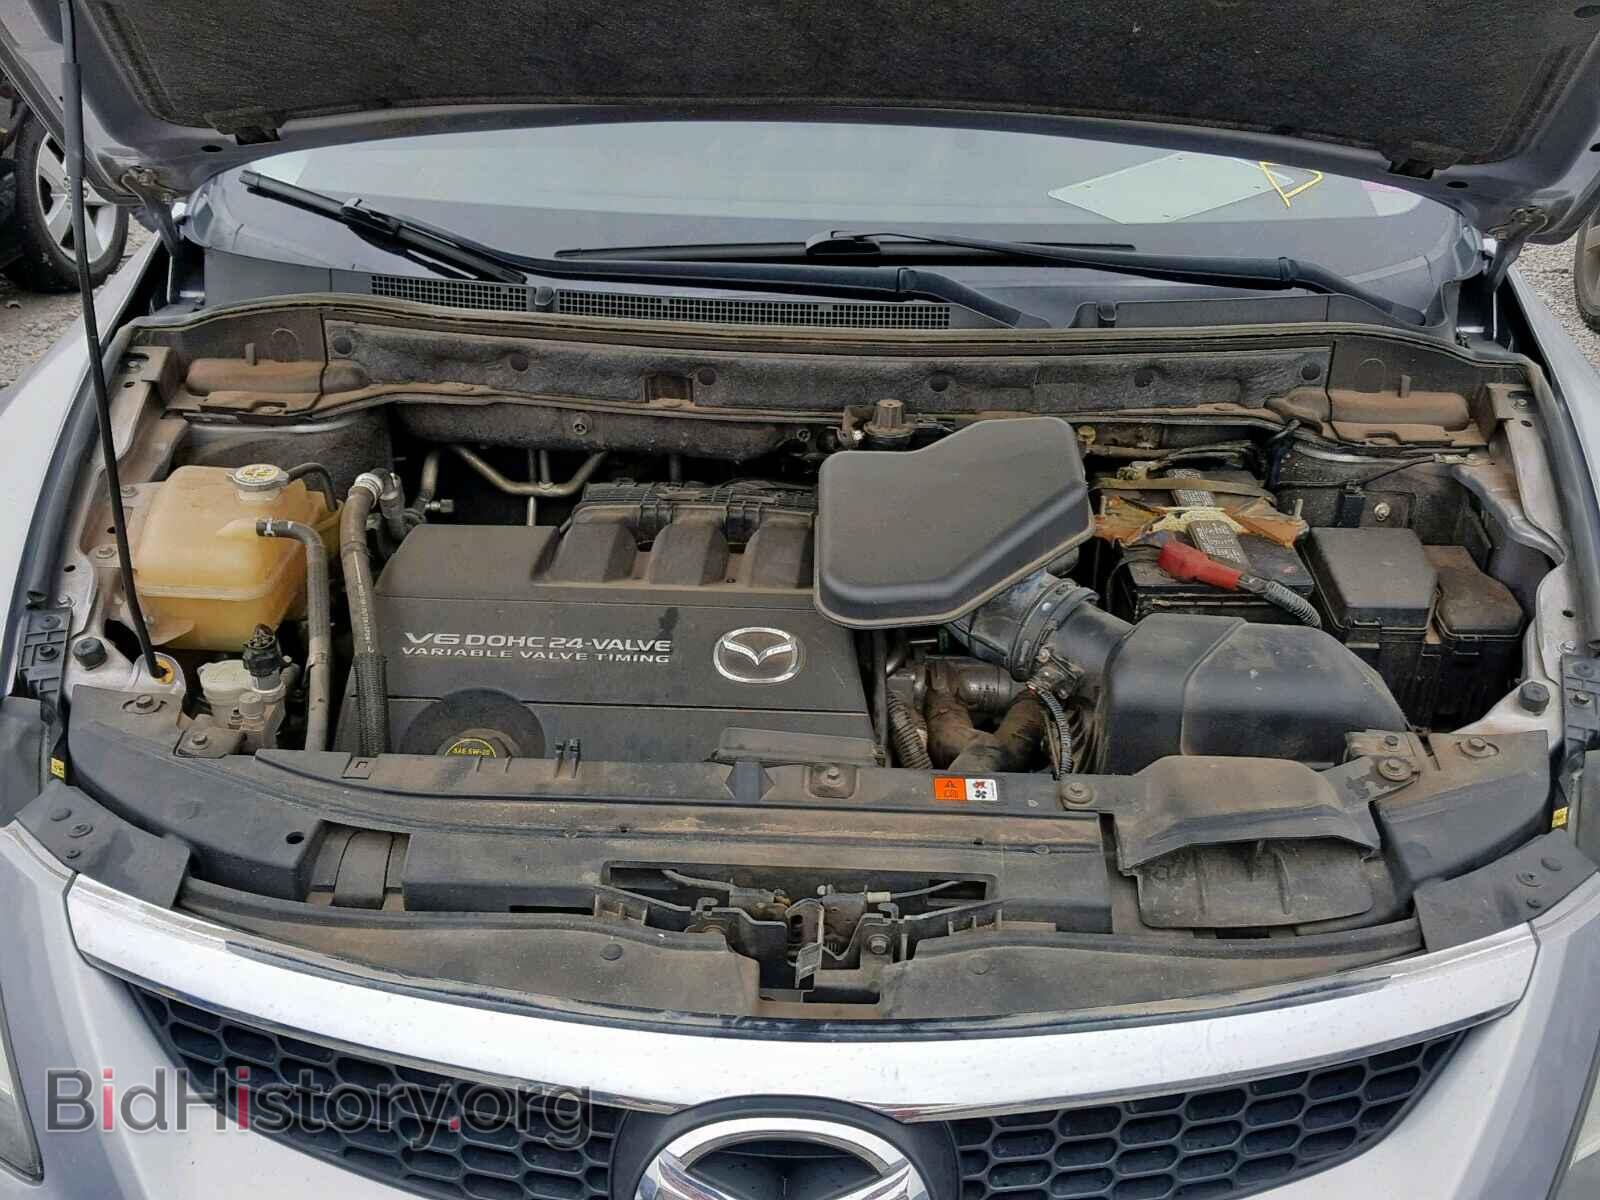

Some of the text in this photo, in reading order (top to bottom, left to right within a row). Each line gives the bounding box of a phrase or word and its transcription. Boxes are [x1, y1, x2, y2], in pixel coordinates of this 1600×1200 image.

[404, 632, 672, 652] V6 DOHC 24-VALVE
[401, 647, 672, 663] VARIABLE VALVE TIMING
